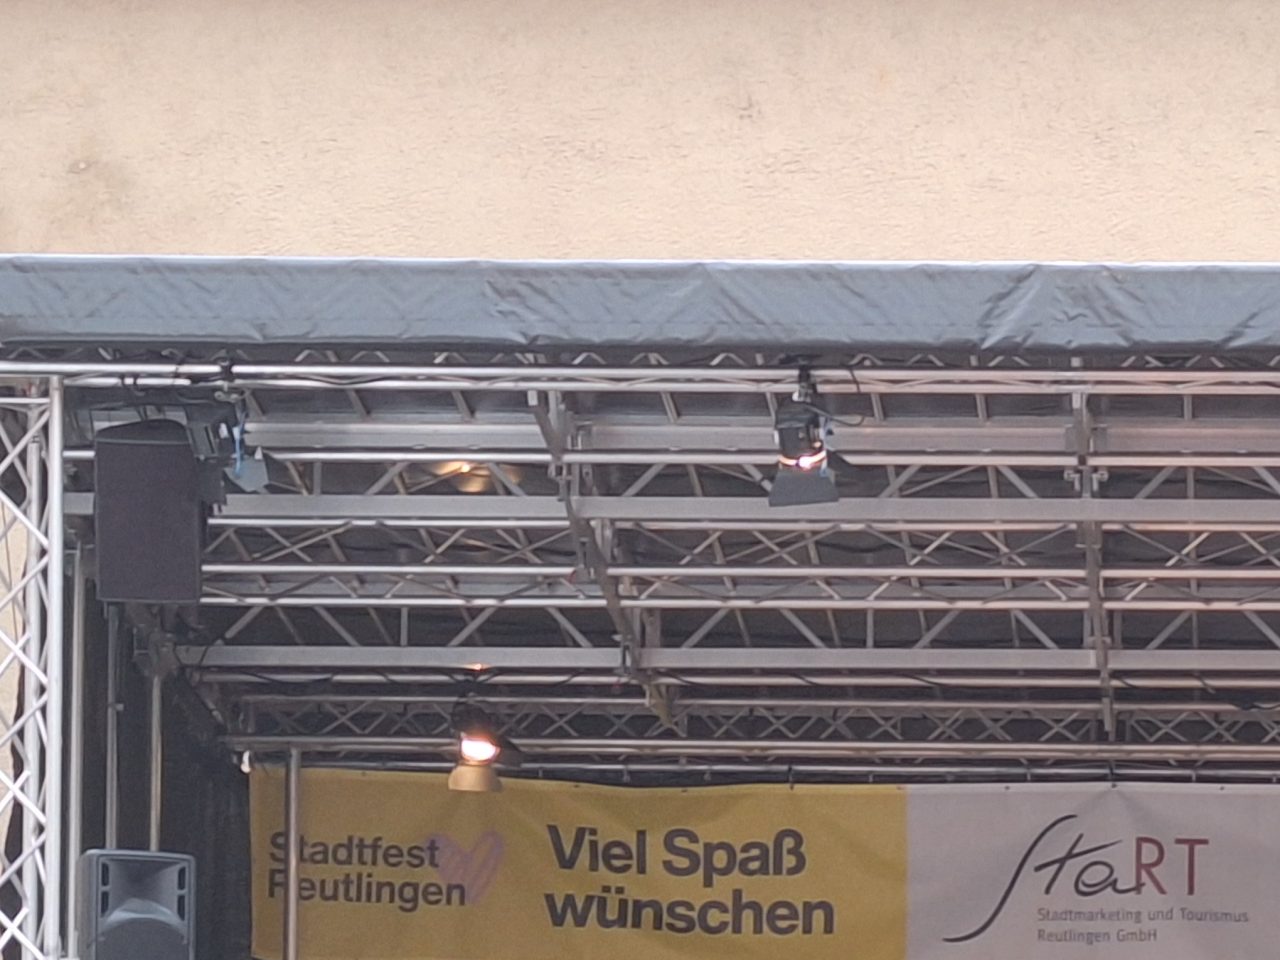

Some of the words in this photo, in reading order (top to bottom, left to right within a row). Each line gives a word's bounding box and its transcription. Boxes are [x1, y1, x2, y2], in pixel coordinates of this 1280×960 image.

[269, 831, 440, 869] Stadtfest
[546, 823, 647, 875] Viel
[661, 828, 807, 888] Spaß
[543, 884, 834, 935] wünschen
[1037, 908, 1143, 924] Stadtmarketing
[1147, 908, 1174, 922] und
[1179, 908, 1250, 923] Tourismus
[1037, 928, 1111, 945] Reutlingen
[1115, 928, 1158, 943] GmbH
